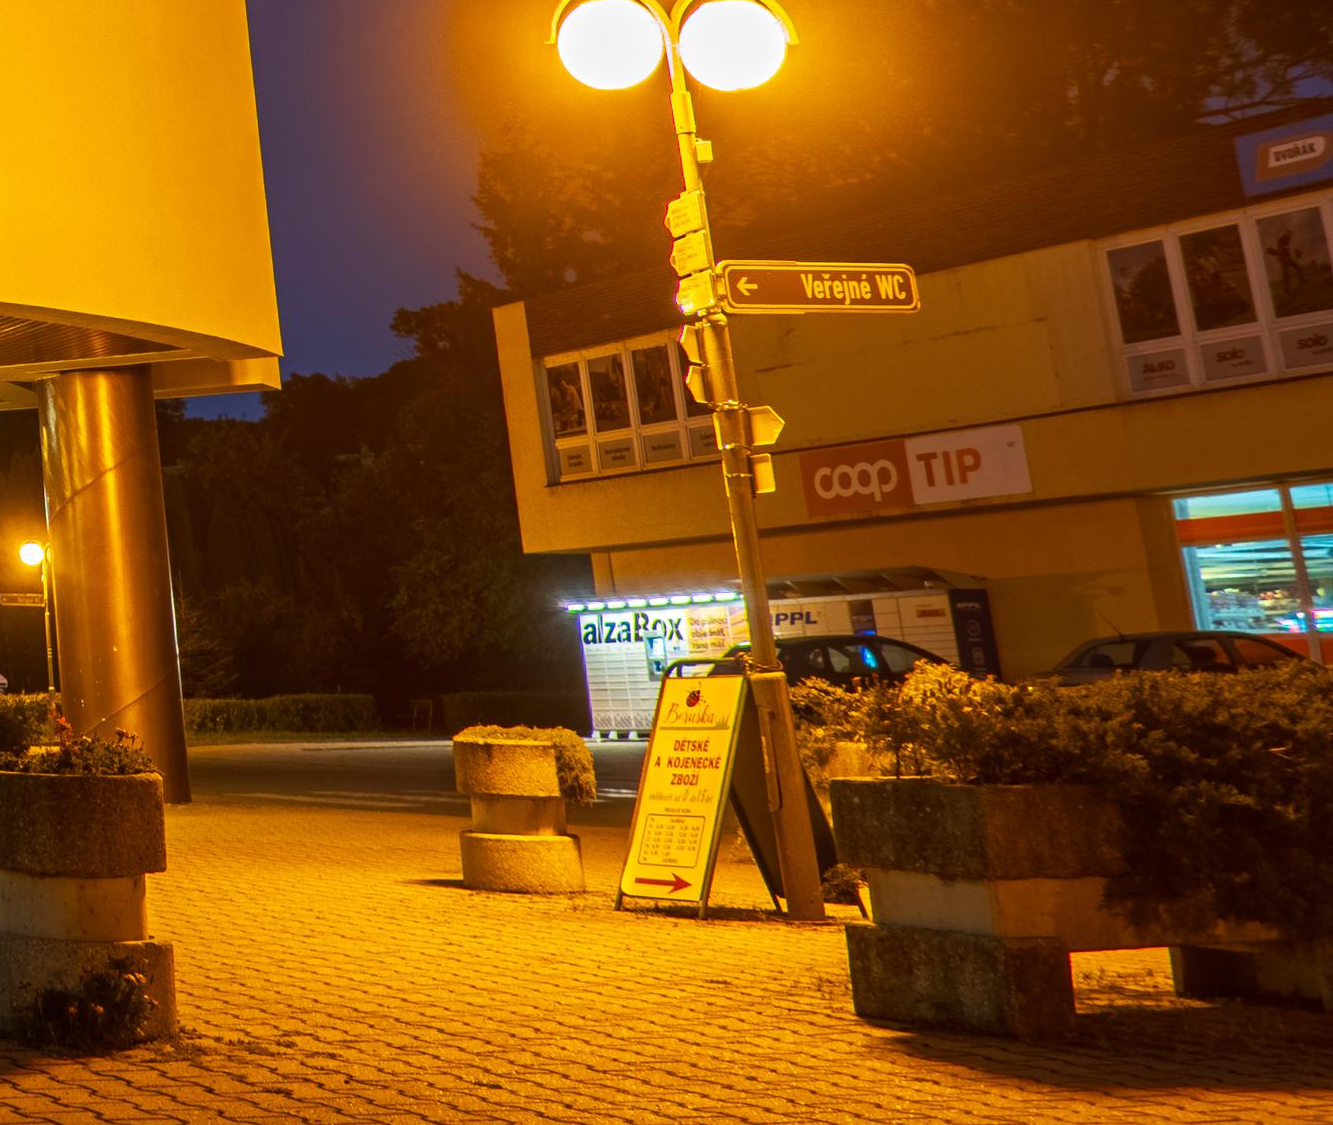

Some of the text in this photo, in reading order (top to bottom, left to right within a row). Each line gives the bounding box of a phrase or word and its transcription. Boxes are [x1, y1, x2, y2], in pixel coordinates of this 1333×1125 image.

[800, 273, 906, 306] Veřejné WC
[814, 459, 898, 501] coop
[916, 448, 982, 487] TIP
[583, 612, 683, 645] alzaBox
[775, 611, 817, 626] PPL
[654, 756, 661, 767] A
